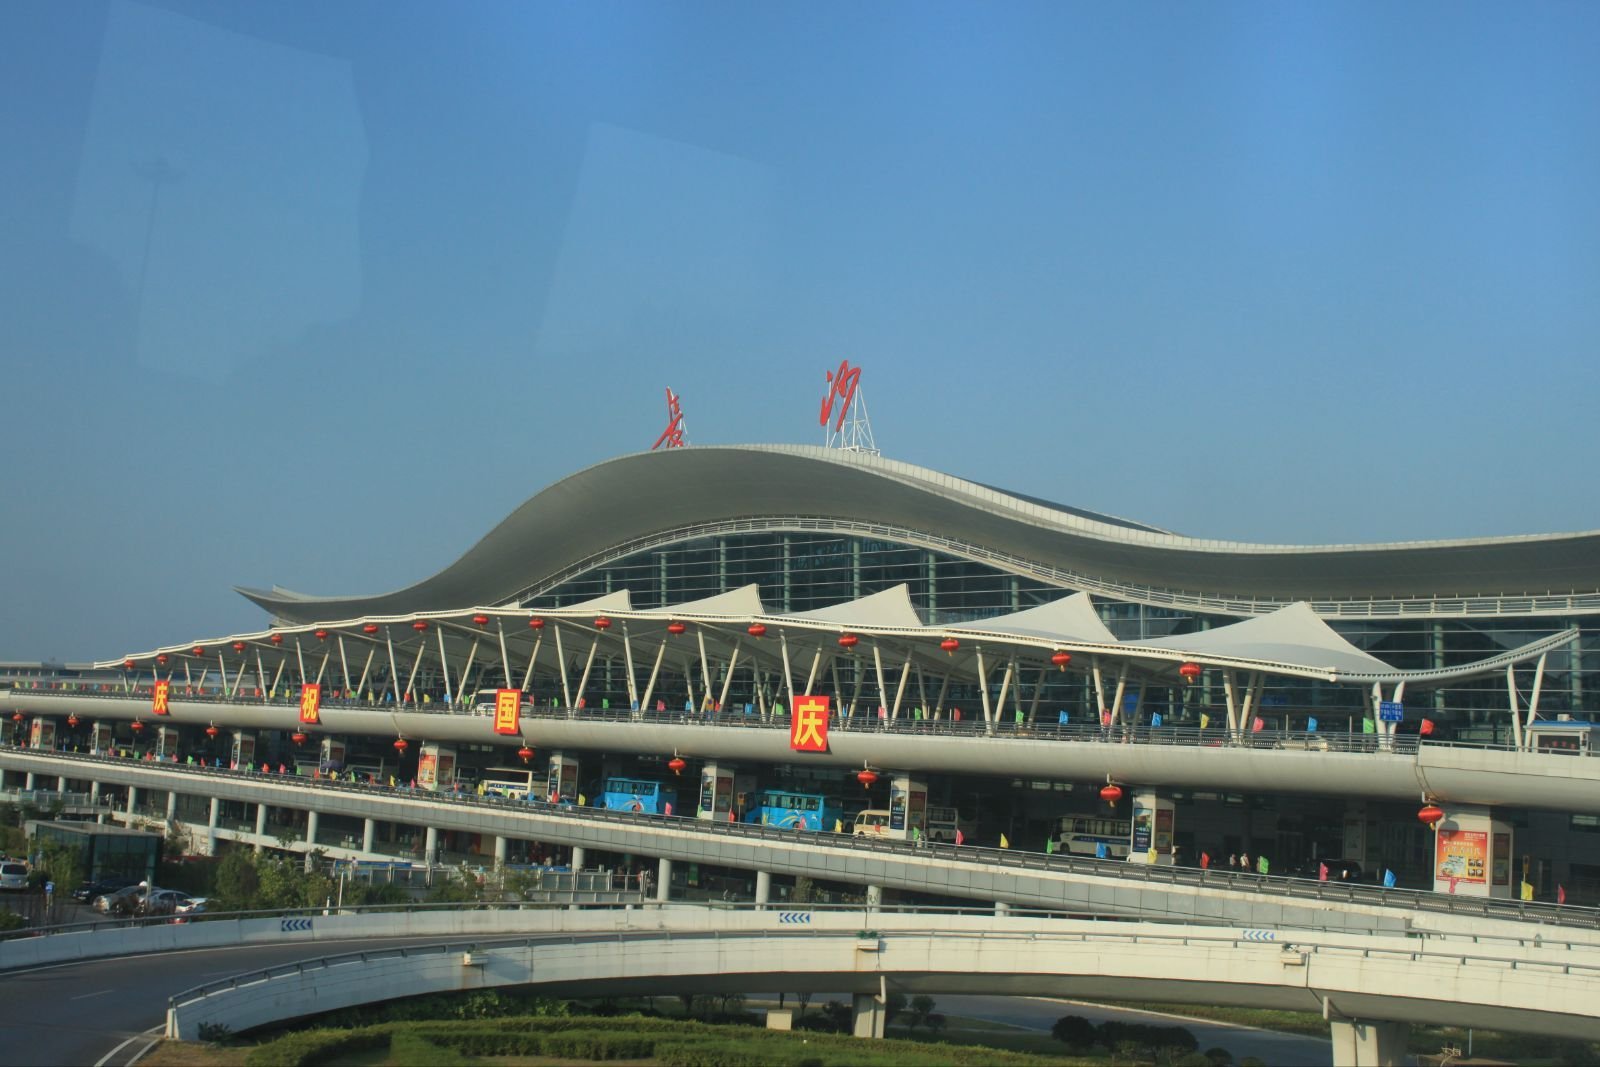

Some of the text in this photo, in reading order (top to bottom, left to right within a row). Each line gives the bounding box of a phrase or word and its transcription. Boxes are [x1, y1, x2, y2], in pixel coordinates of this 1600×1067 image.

[154, 683, 168, 712] 庆
[302, 687, 318, 720] 祝
[496, 693, 517, 730] 国
[793, 699, 825, 748] 庆
